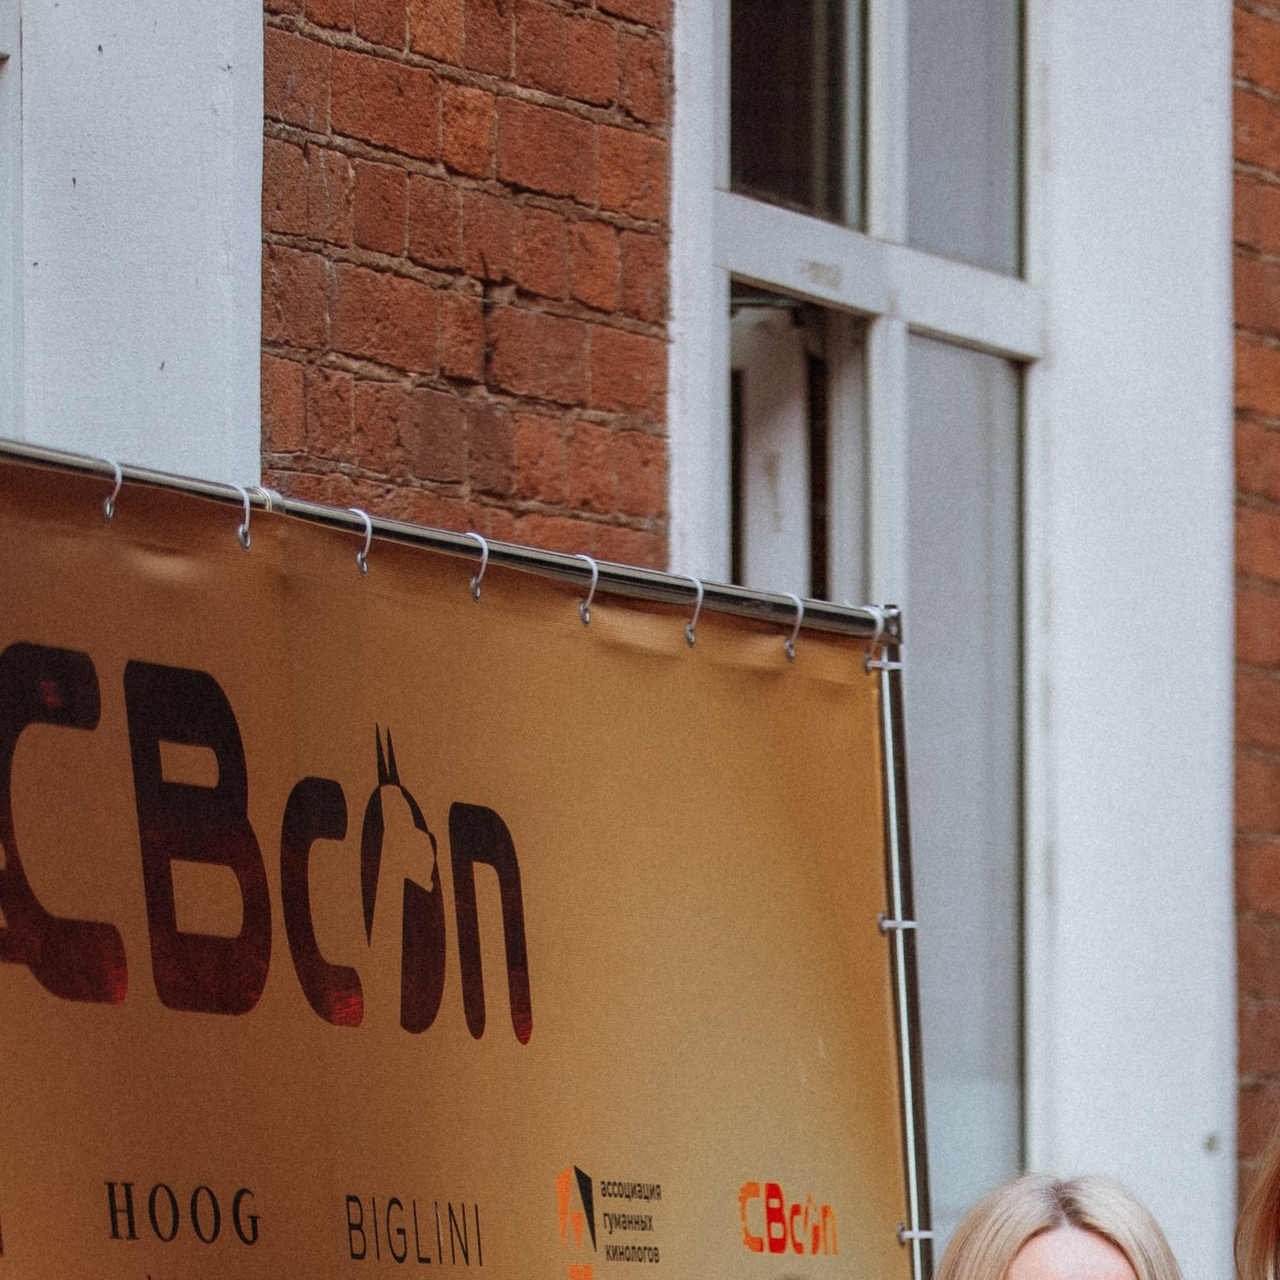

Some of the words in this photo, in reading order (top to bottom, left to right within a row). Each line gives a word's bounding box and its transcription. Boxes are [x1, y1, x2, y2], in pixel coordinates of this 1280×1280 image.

[601, 1180, 663, 1203] ассоциация
[104, 1180, 262, 1246] HOOG
[603, 1212, 654, 1235] гуманных
[346, 1195, 483, 1267] BIGLINI
[605, 1245, 660, 1264] кинологов
